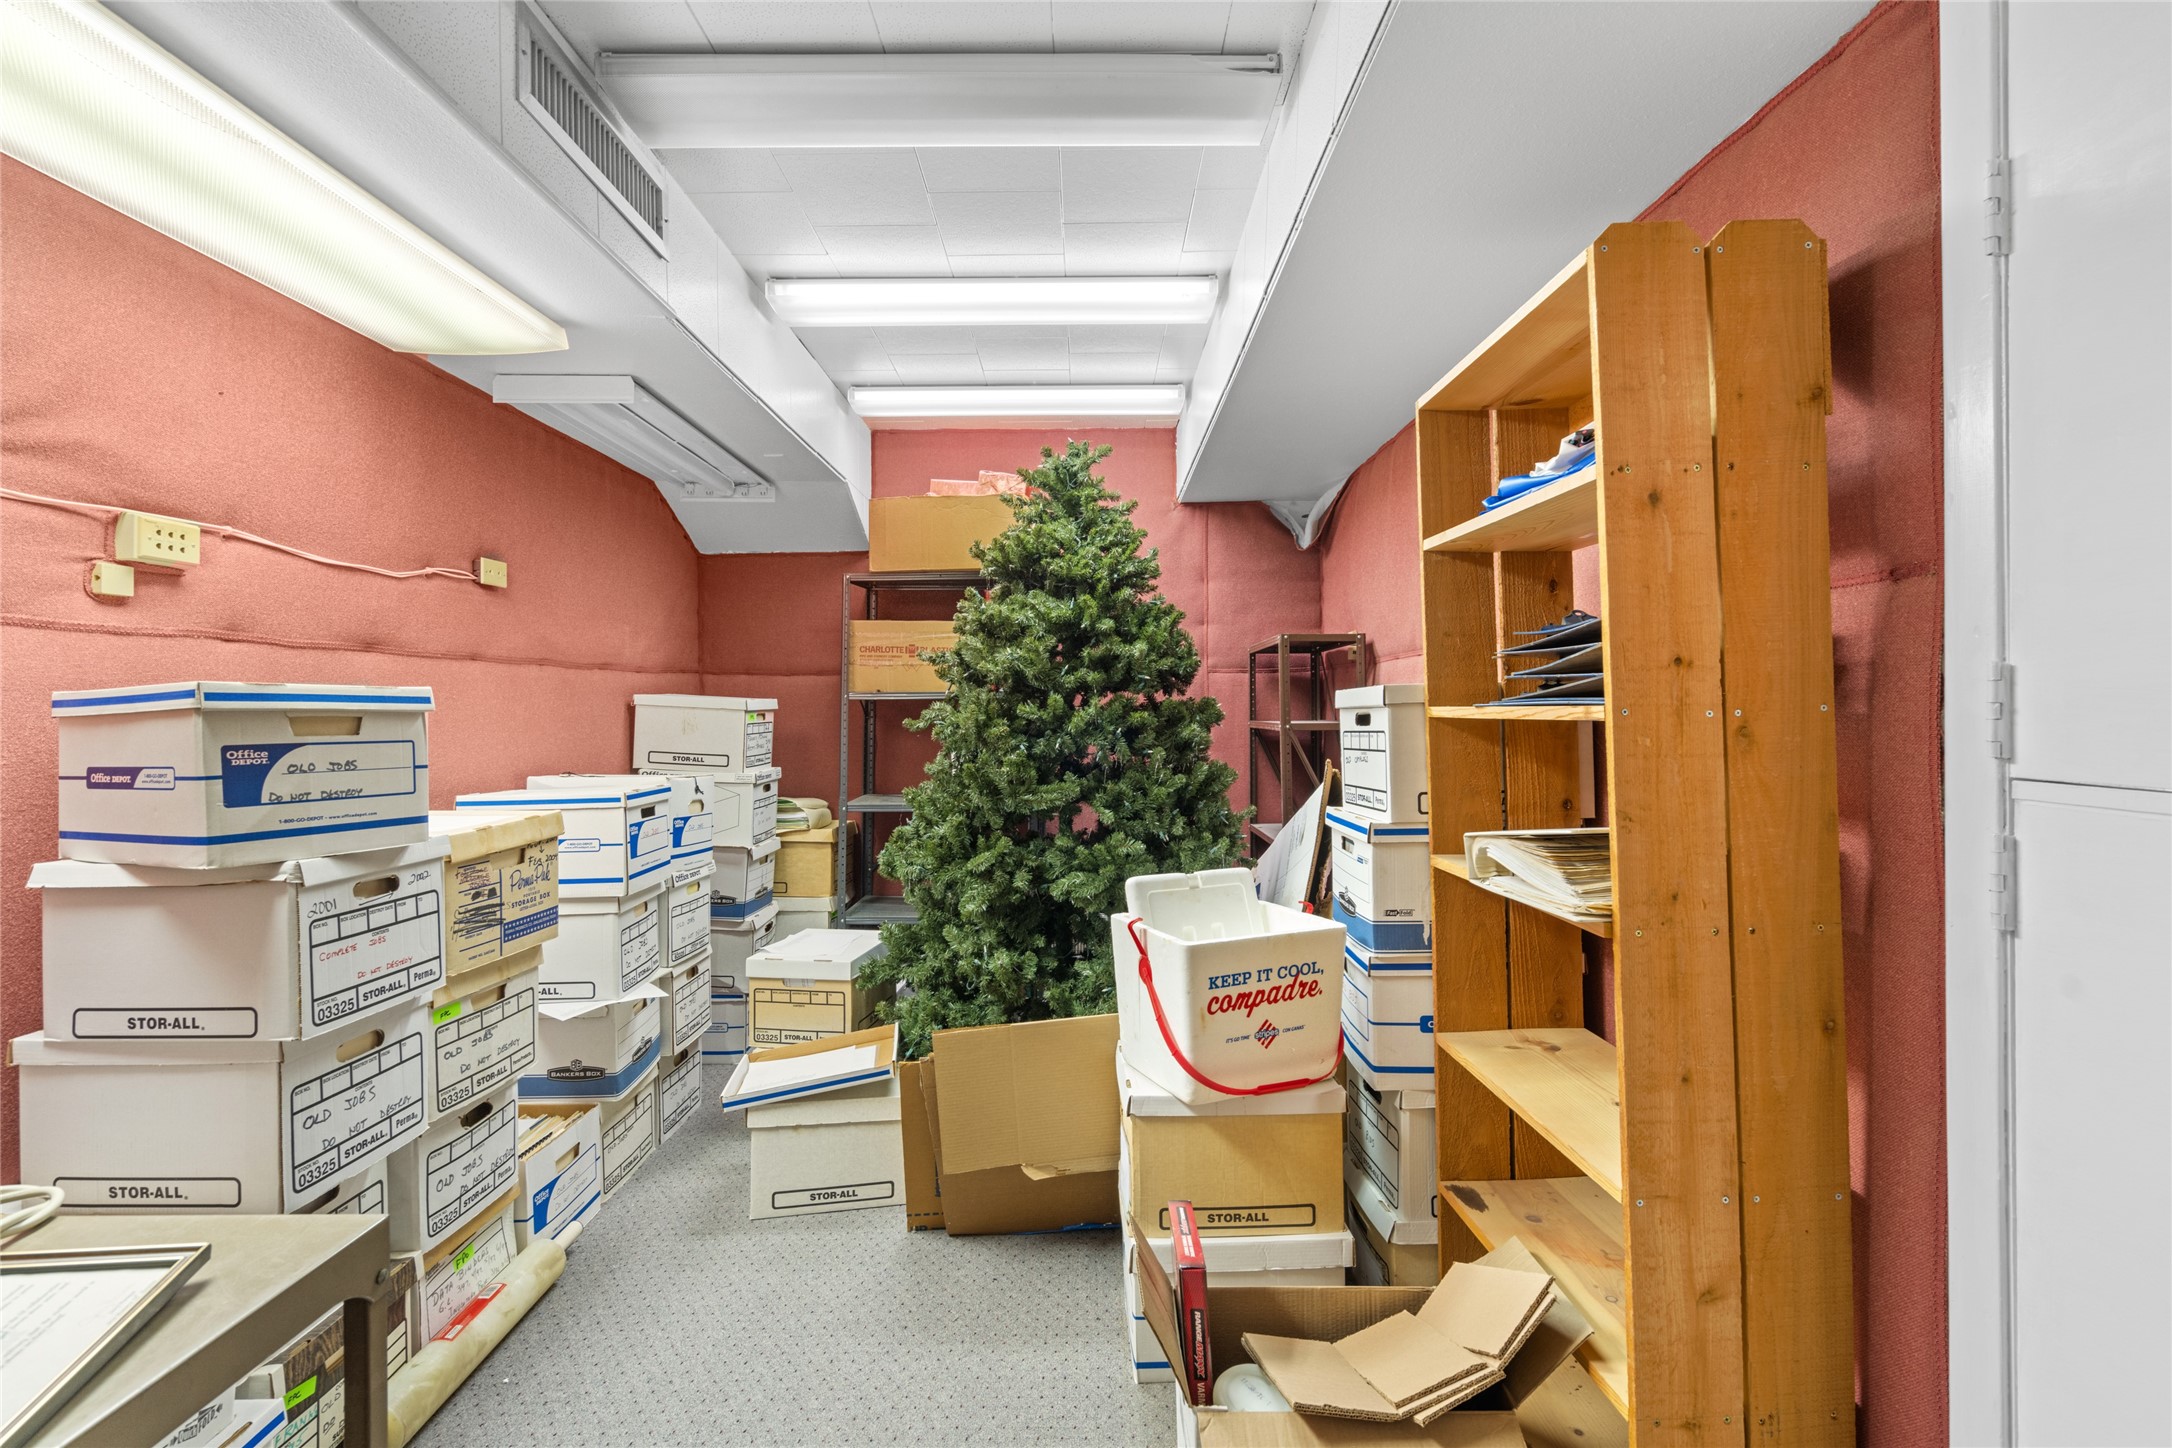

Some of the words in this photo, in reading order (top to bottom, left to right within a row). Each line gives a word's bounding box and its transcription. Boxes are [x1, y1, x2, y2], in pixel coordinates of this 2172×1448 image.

[860, 646, 904, 654] CHARLOTTE
[226, 749, 268, 759] Office
[231, 758, 268, 766] DEPOT
[287, 763, 316, 774] OLD
[327, 760, 358, 772] JOBS
[91, 773, 111, 783] Office
[290, 792, 312, 801] NOT
[321, 788, 363, 799] DESTROY
[675, 873, 689, 883] Office
[307, 898, 337, 919] 2001
[512, 896, 536, 908] STORAGE
[319, 943, 357, 961] COMPLETE
[369, 936, 386, 946] JOBS
[1208, 972, 1252, 990] KEEP
[1257, 968, 1273, 982] IT
[1277, 962, 1324, 979] COOL,
[317, 998, 355, 1021] 03325
[362, 980, 404, 1001] STOR-ALL
[413, 969, 434, 981] Perma
[1207, 970, 1323, 1018] compadre.
[127, 1017, 200, 1030] STOR-ALL
[1255, 1028, 1279, 1040] stripes
[444, 1047, 463, 1060] OLD
[441, 1086, 470, 1108] 03325
[476, 1066, 508, 1087] STOR-ALL
[303, 1109, 332, 1129] OLD
[344, 1085, 376, 1110] JOBS
[349, 1118, 368, 1136] NOT
[298, 1158, 336, 1188] 03325
[344, 1130, 386, 1159] STOR-ALL
[396, 1112, 415, 1128] Perma
[436, 1174, 454, 1192] OLD
[109, 1186, 183, 1199] STOR-ALL
[810, 1190, 858, 1201] STOR-ALL
[432, 1207, 458, 1232] 03325
[464, 1183, 492, 1207] STOR-ALL
[1207, 1213, 1269, 1223] STOR-ALL
[432, 1282, 453, 1307] DATA
[321, 1393, 341, 1413] OLD
